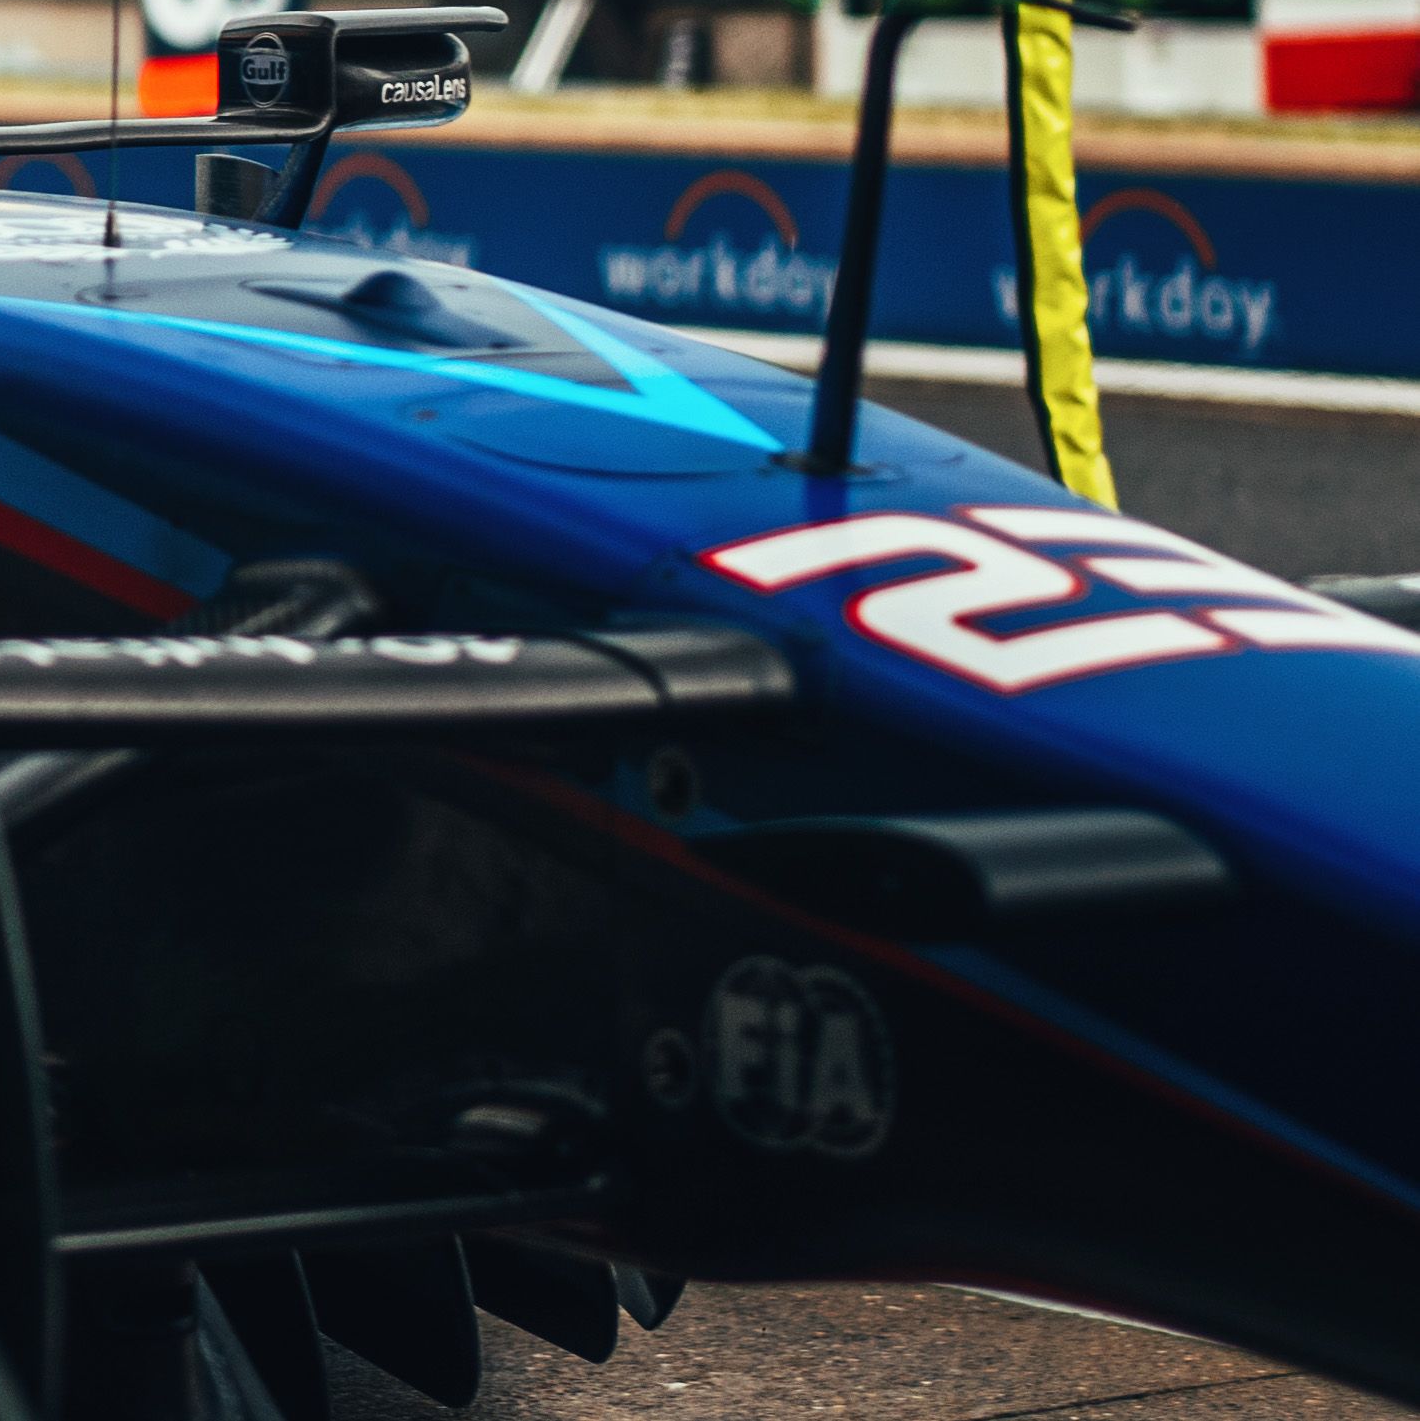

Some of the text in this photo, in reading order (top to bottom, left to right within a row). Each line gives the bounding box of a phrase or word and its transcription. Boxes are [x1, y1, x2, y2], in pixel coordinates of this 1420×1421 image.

[243, 58, 288, 81] Gulf
[381, 74, 467, 104] causaLens
[995, 254, 1274, 349] wrkday
